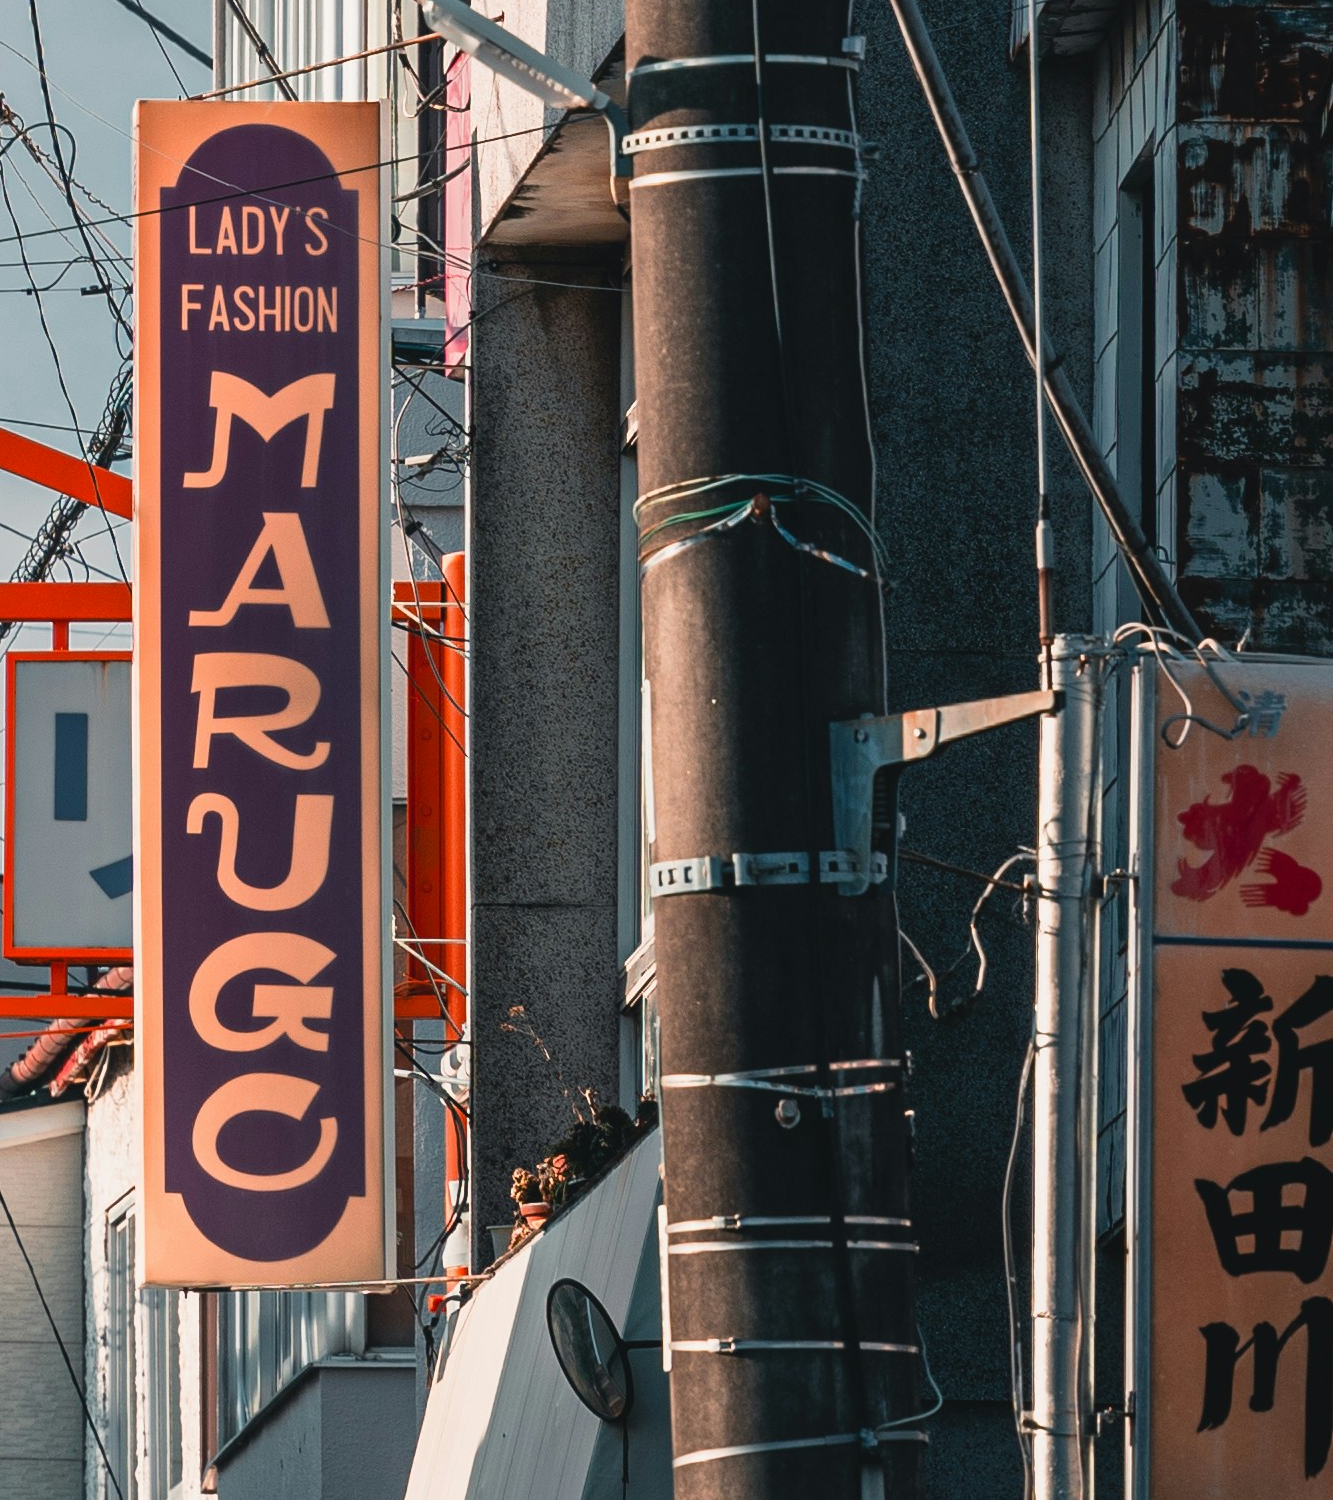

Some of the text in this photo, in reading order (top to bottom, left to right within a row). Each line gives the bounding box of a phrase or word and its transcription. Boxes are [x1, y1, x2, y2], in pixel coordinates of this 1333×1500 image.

[187, 205, 330, 258] LADY'S
[180, 283, 339, 334] FASHION
[1181, 966, 1333, 1482] 新田川
